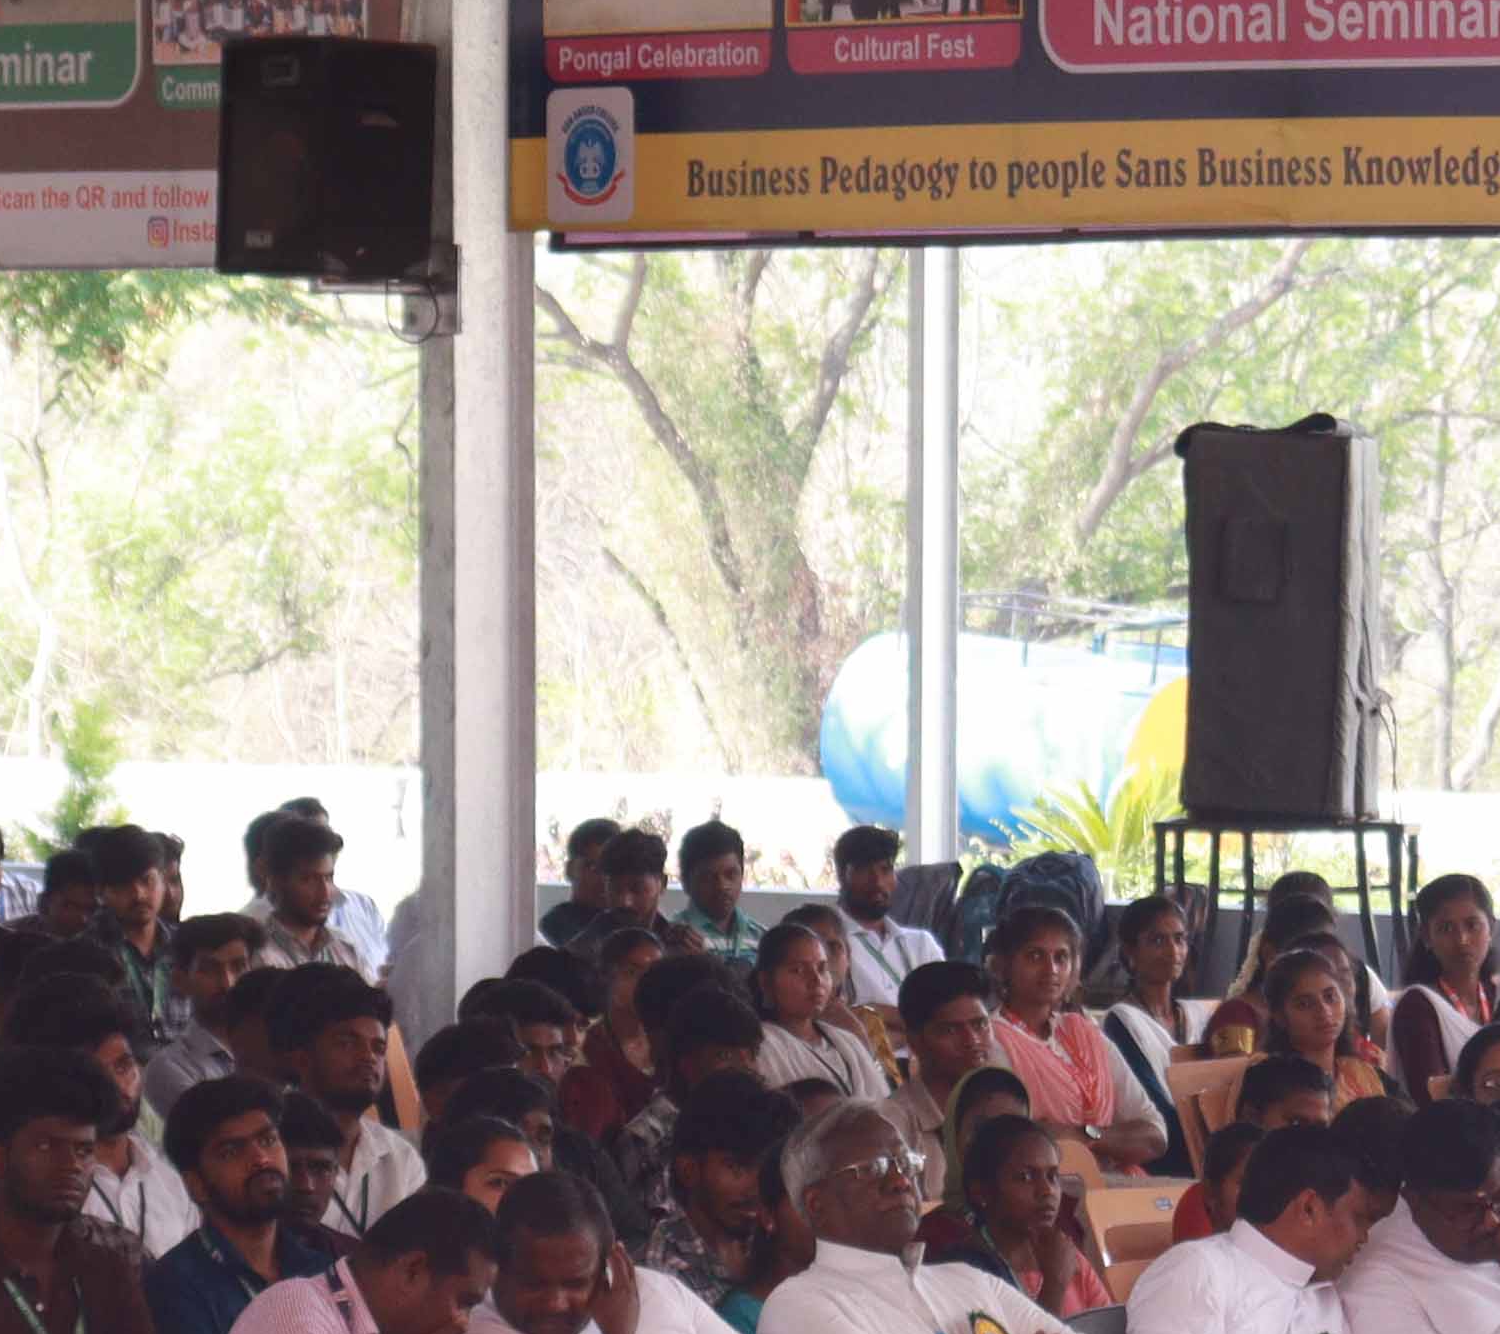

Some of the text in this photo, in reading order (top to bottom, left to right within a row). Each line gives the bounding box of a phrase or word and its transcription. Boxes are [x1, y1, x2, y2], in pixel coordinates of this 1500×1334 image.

[558, 39, 759, 78] Pongal Celebration
[833, 33, 974, 63] Cultural Fest
[686, 159, 811, 197] Business
[820, 157, 960, 203] Pedagogy
[968, 160, 1000, 191] to
[1007, 152, 1106, 200] people
[1114, 149, 1188, 188] Sans
[1196, 148, 1334, 187] Business
[41, 186, 69, 209] the
[75, 185, 105, 210] QR
[111, 185, 147, 208] and
[153, 184, 209, 208] follow
